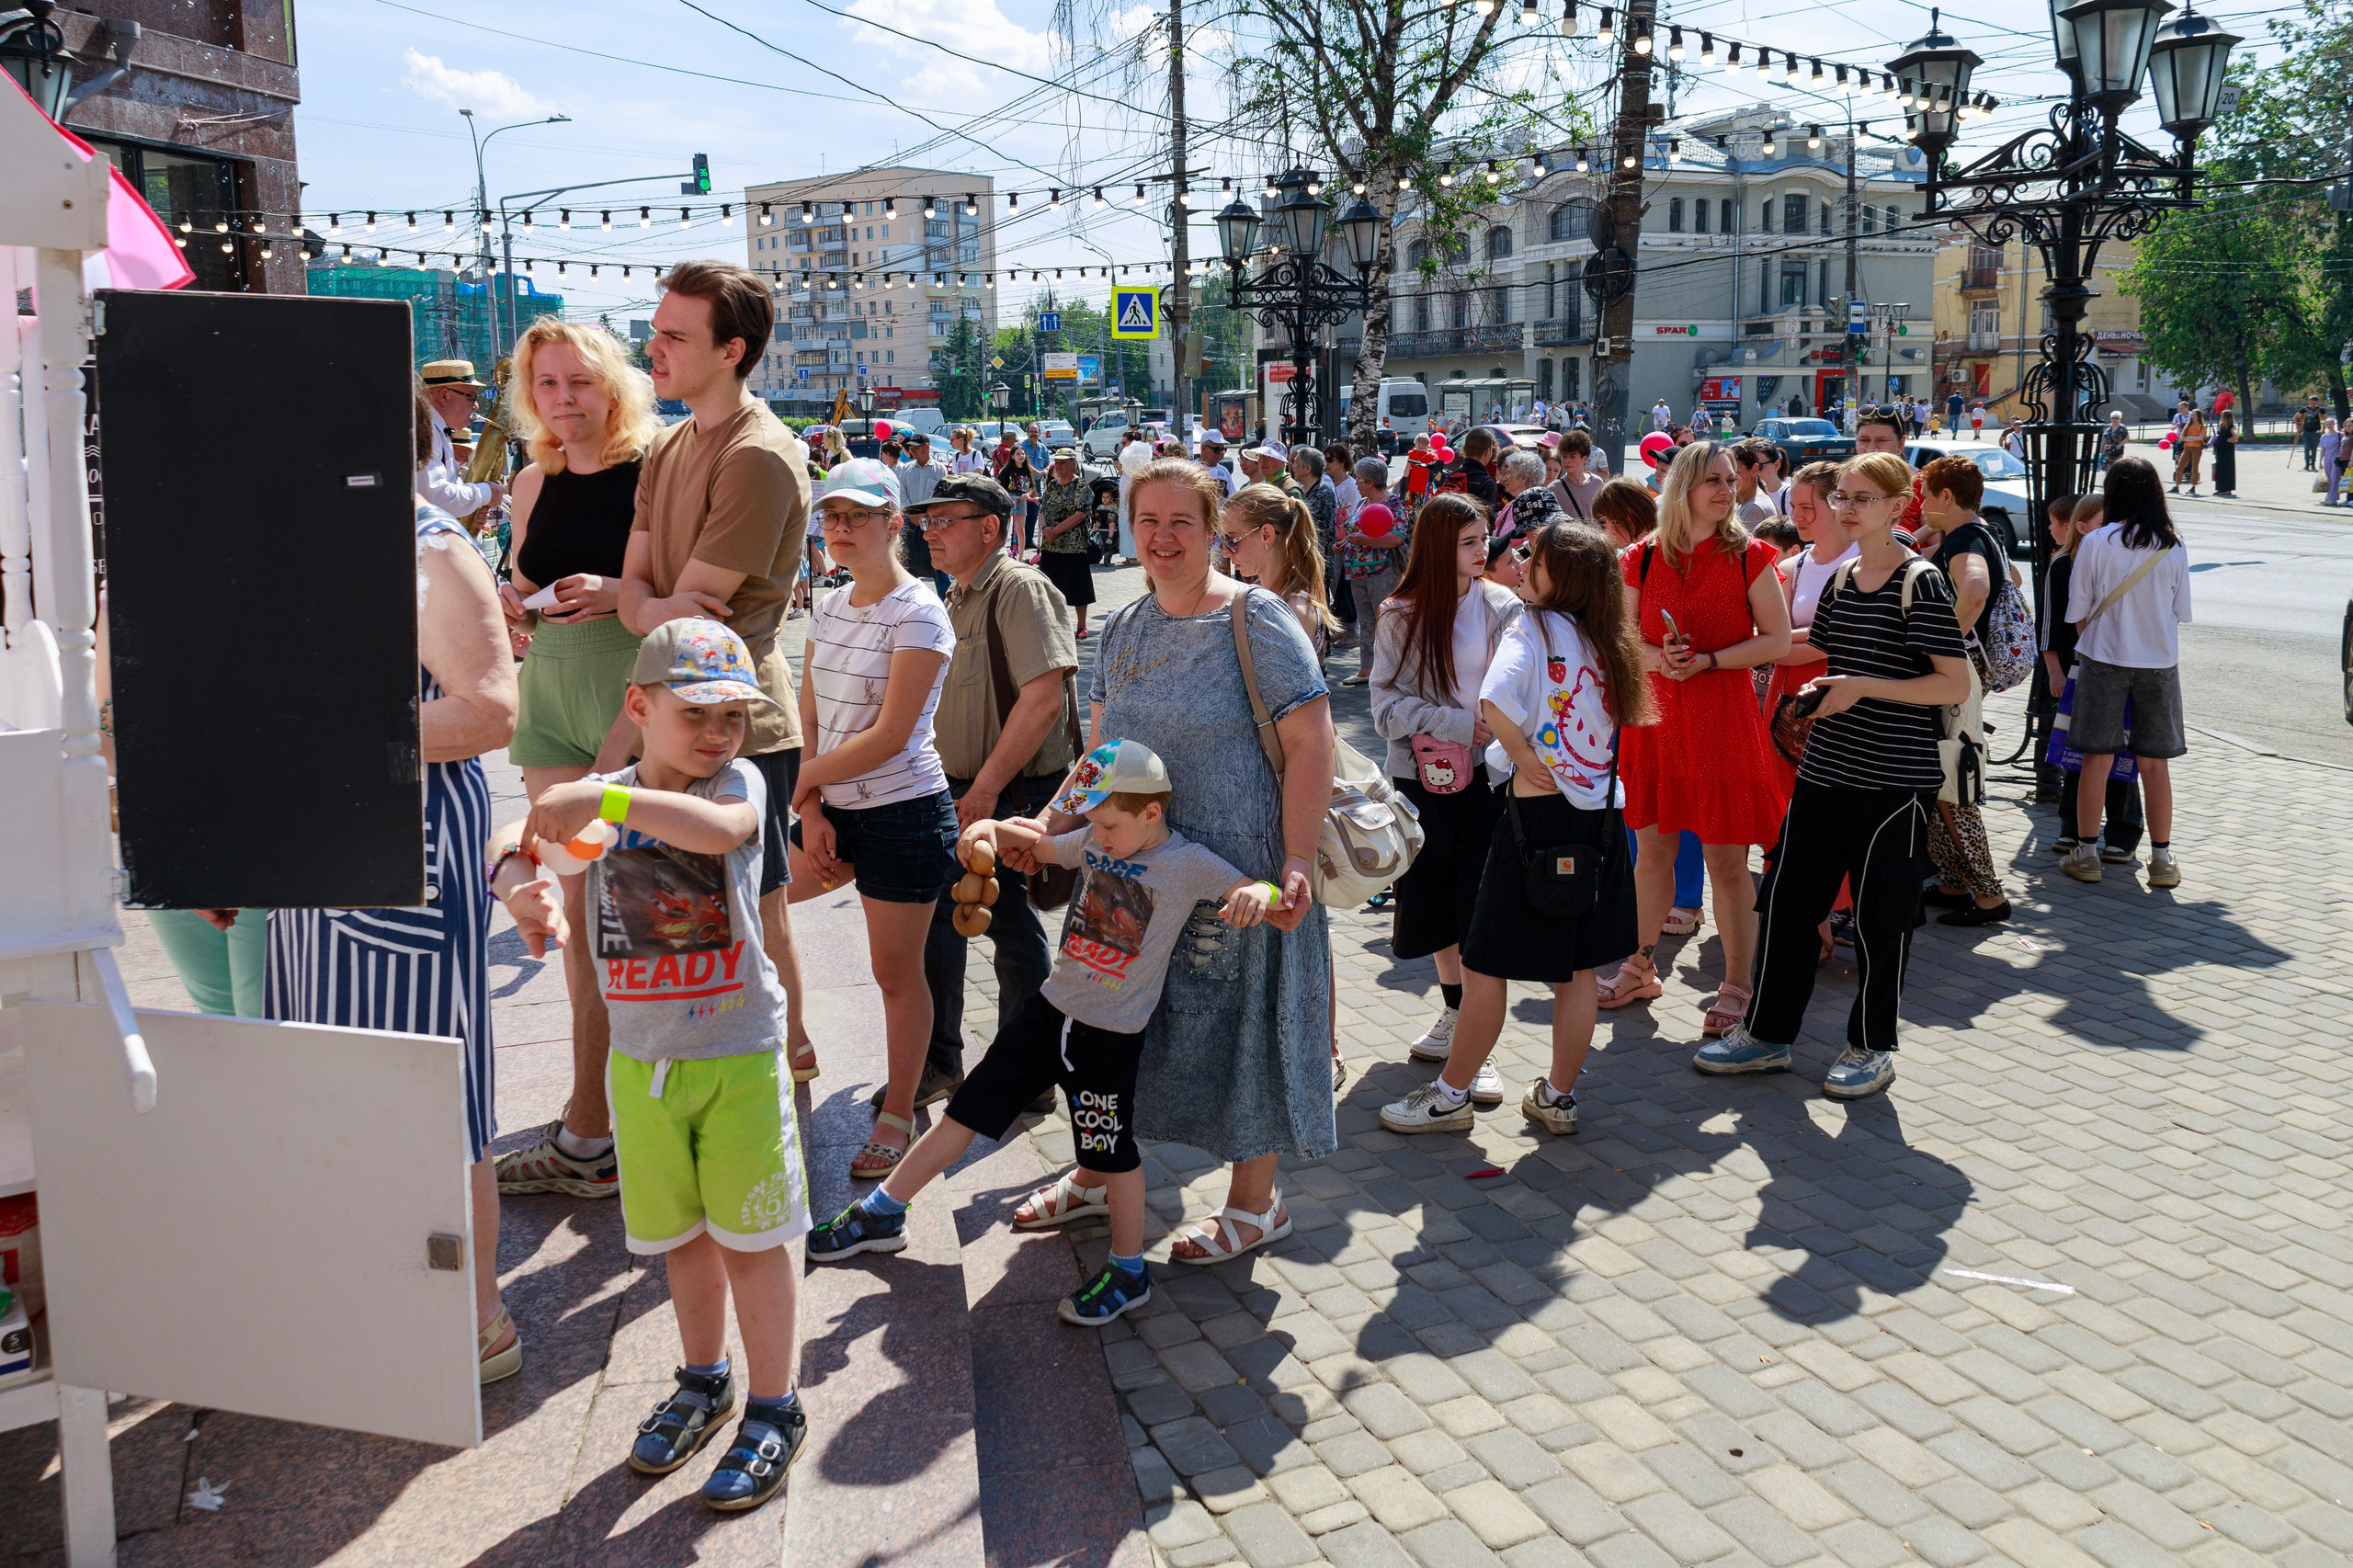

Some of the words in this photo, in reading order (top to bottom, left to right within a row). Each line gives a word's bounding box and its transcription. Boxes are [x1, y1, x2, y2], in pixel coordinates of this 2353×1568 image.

[2097, 332, 2117, 340] ДЕНЬ
[2121, 332, 2141, 340] НОЧЬ
[1811, 350, 1844, 360] SPA
[606, 939, 746, 990] READY
[1080, 1090, 1119, 1110] ONE
[1074, 1110, 1122, 1131] COOL
[1080, 1132, 1119, 1153] BOY
